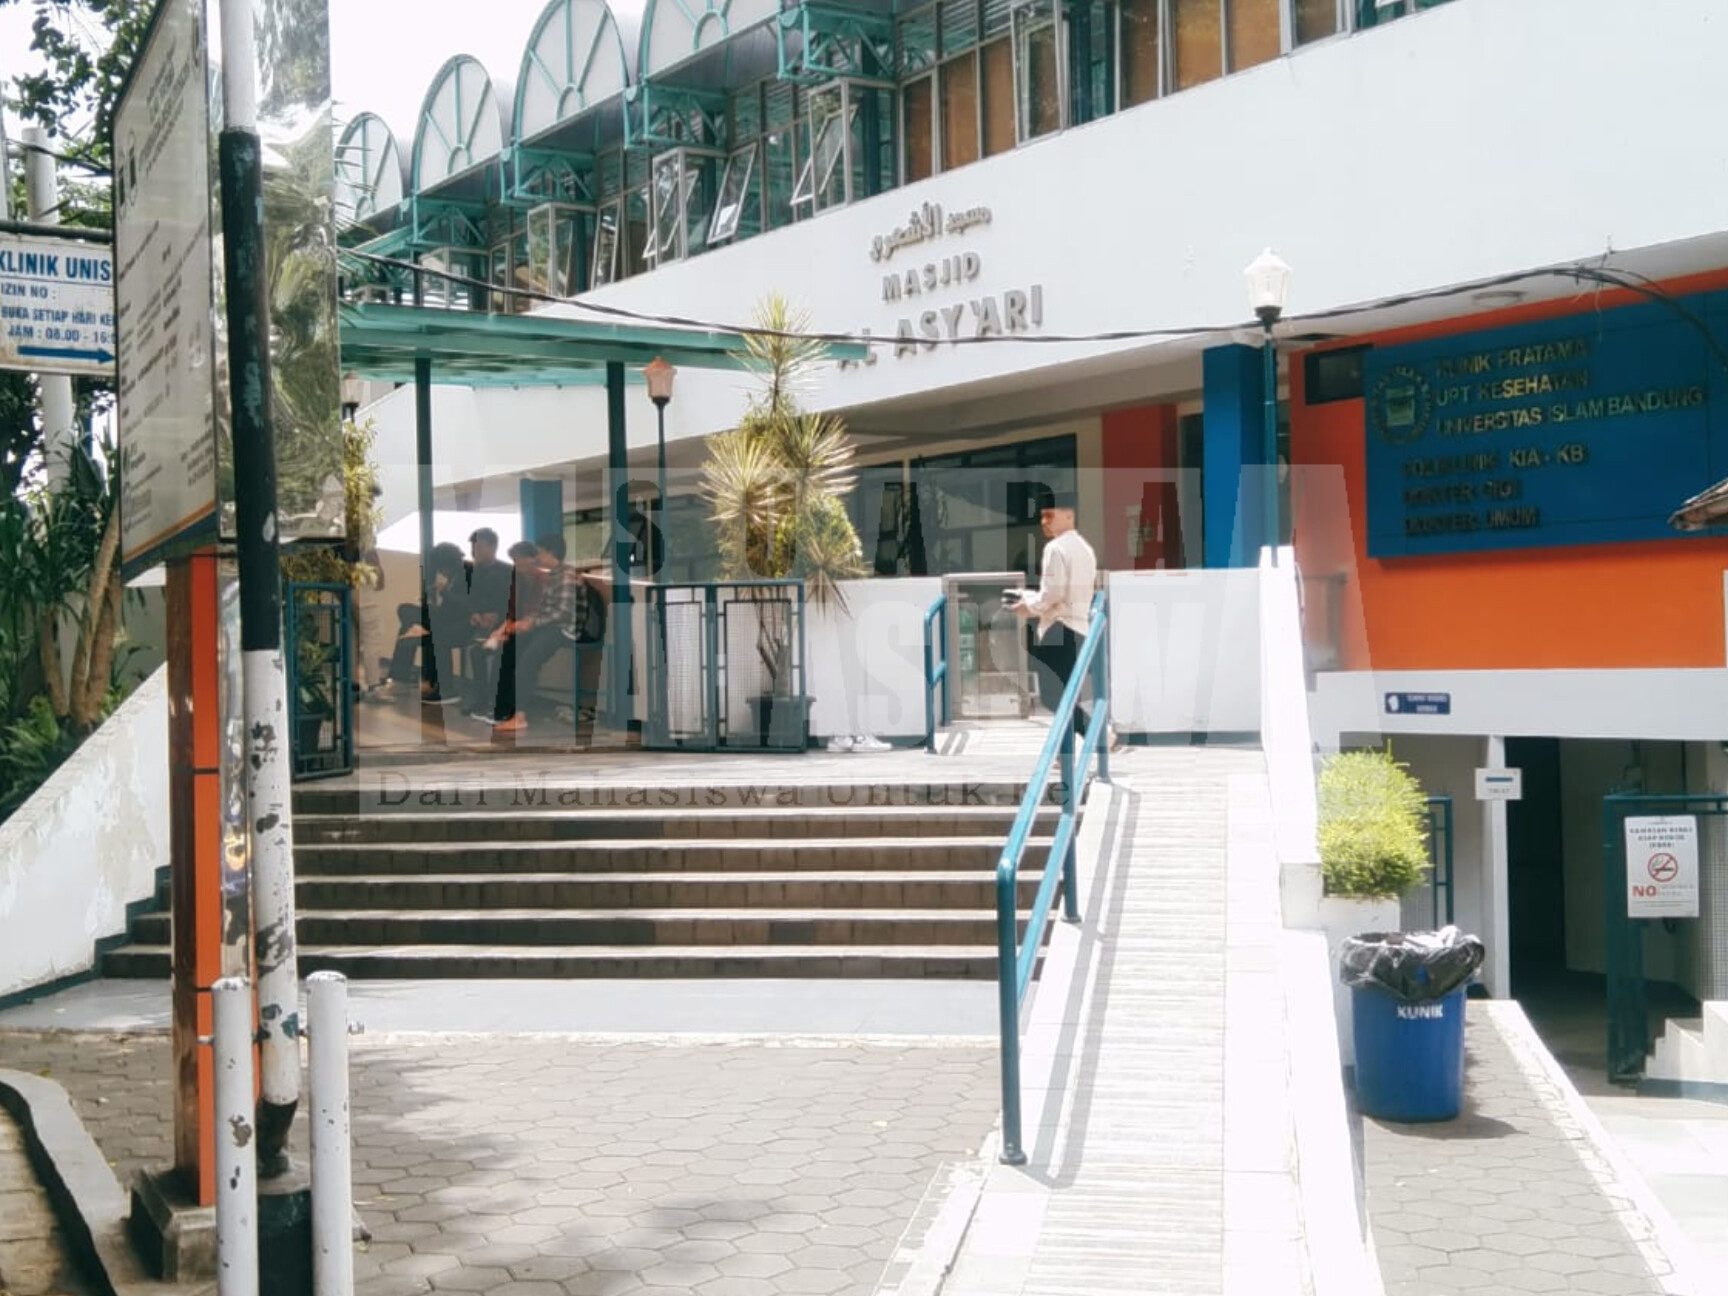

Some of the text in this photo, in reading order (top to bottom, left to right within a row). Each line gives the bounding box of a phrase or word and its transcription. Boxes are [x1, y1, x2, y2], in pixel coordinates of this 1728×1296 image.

[0, 250, 59, 277] KLINIK
[882, 252, 981, 304] MASJID
[1556, 444, 1585, 464] KB
[1632, 885, 1657, 897] NO
